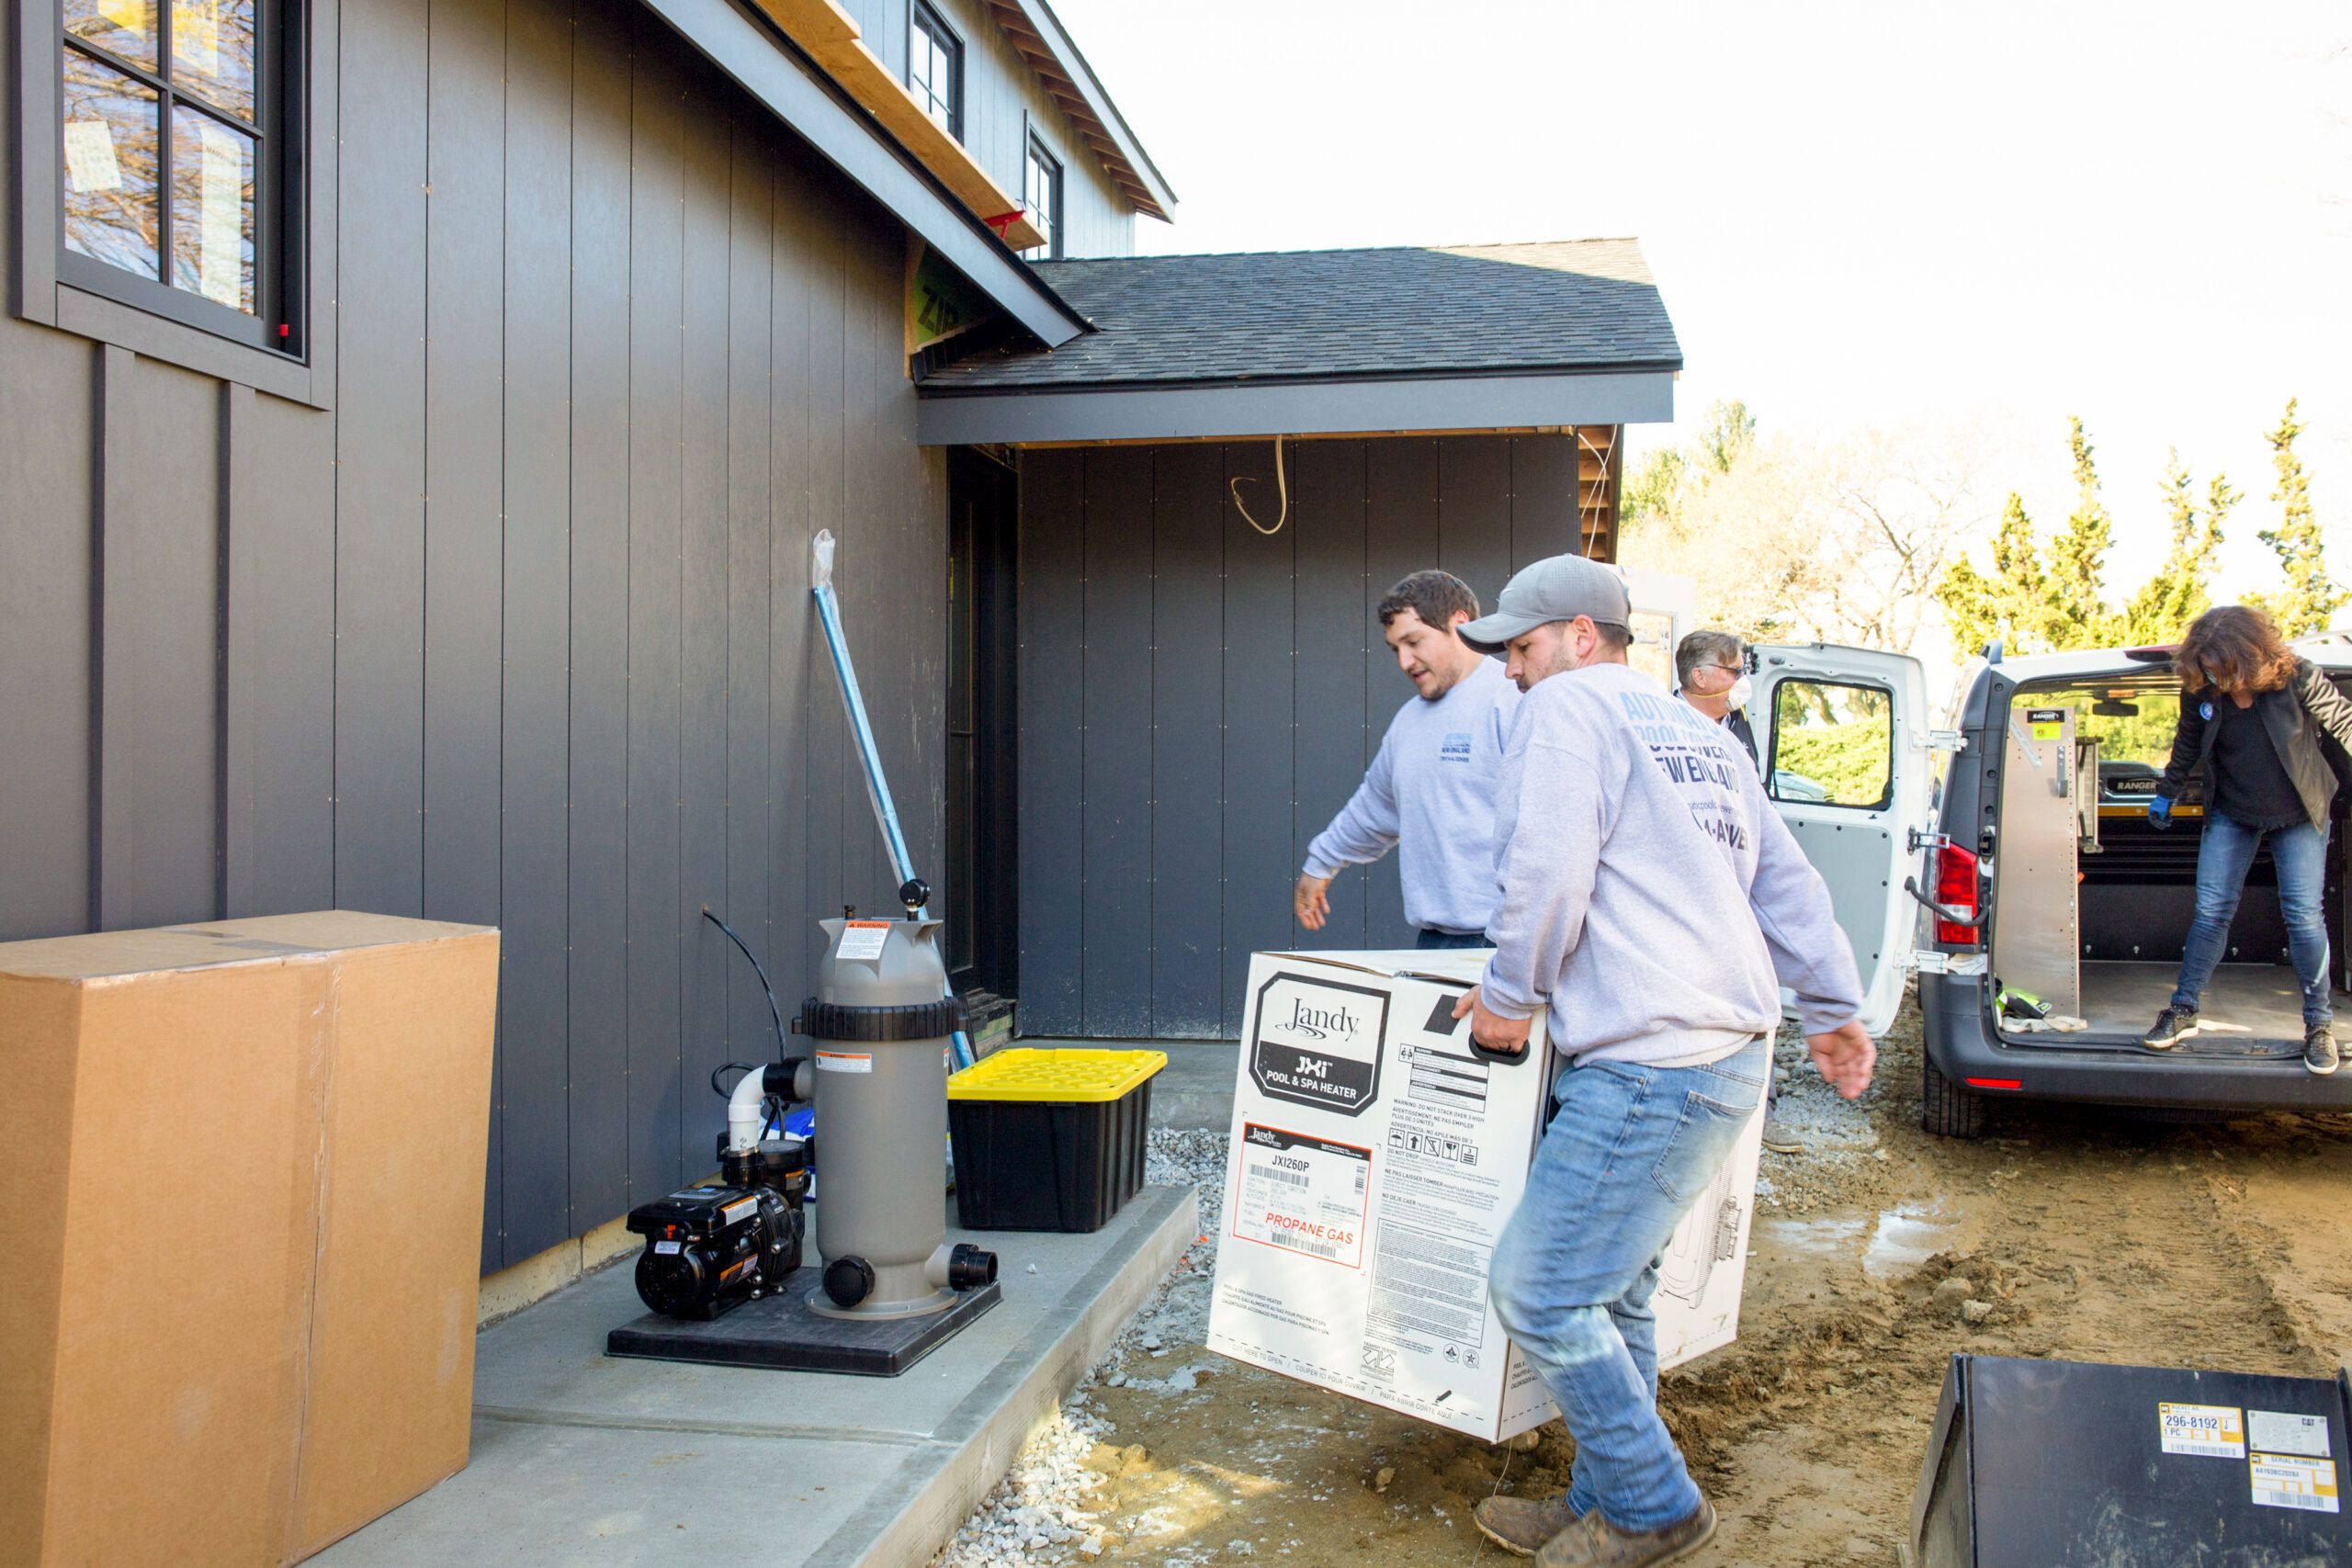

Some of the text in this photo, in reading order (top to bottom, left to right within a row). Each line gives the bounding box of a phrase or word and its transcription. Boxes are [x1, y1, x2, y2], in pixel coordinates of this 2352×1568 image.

[2117, 782, 2157, 790] RANGER
[1284, 997, 1361, 1042] Jandy
[1266, 1069, 1356, 1099] POOL & SPA HEATER
[1437, 1108, 1453, 1116] STACK
[1452, 1119, 1474, 1129] EMPILER
[1248, 1127, 1276, 1146] Jandy
[1434, 1130, 1448, 1138] APILE
[1406, 1152, 1419, 1160] DROP
[1272, 1153, 1309, 1173] JXI260P
[1402, 1172, 1422, 1181] LAISSER
[1423, 1178, 1442, 1187] TOMBER
[1265, 1210, 1324, 1238] PROPANE
[1326, 1226, 1353, 1246] GAS
[1231, 1343, 1242, 1352] CUT
[1244, 1348, 1257, 1357] HERE
[1259, 1352, 1266, 1360] TO
[1267, 1355, 1282, 1365] OPEN
[1295, 1364, 1317, 1377] COUPER
[1328, 1373, 1343, 1383] POUR
[1344, 1379, 1366, 1392] OUVRIR
[1379, 1390, 1396, 1401] PARA
[1396, 1395, 1414, 1407] ABRIR
[1416, 1402, 1435, 1414] CORTE
[2165, 1415, 2218, 1429] 296-8192
[2301, 1417, 2315, 1426] CAT
[2170, 1427, 2181, 1436] PC
[2293, 1458, 2321, 1467] NUMBER
